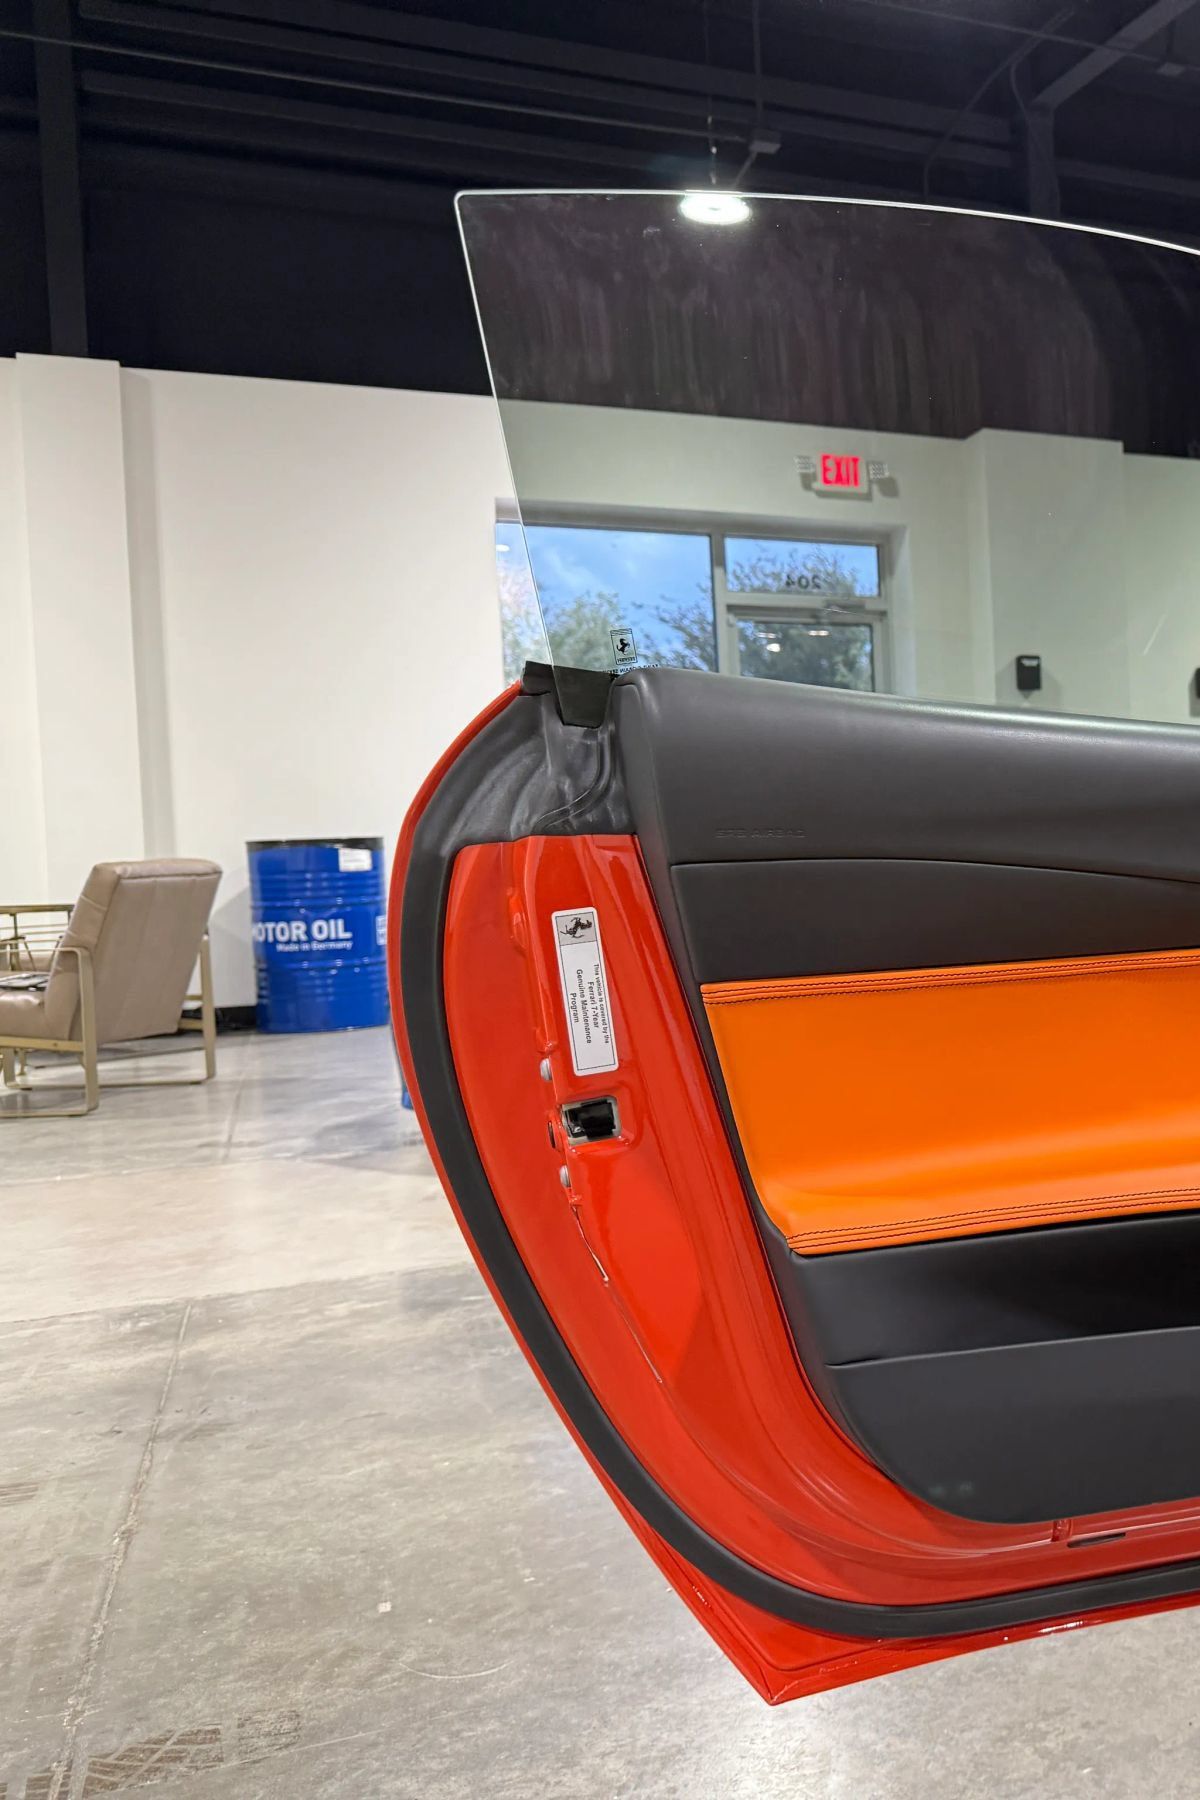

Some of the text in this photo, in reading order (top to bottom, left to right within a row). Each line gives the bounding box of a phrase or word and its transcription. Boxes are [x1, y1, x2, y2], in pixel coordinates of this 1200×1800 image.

[821, 454, 859, 487] EXIT
[311, 919, 353, 941] OIL
[276, 942, 299, 952] Made
[311, 941, 353, 951] Germany
[570, 992, 579, 1023] Program
[577, 969, 592, 1044] Genuine Maintenance
[588, 981, 599, 1028] Ferrari 7-Year
[602, 1026, 608, 1034] by
